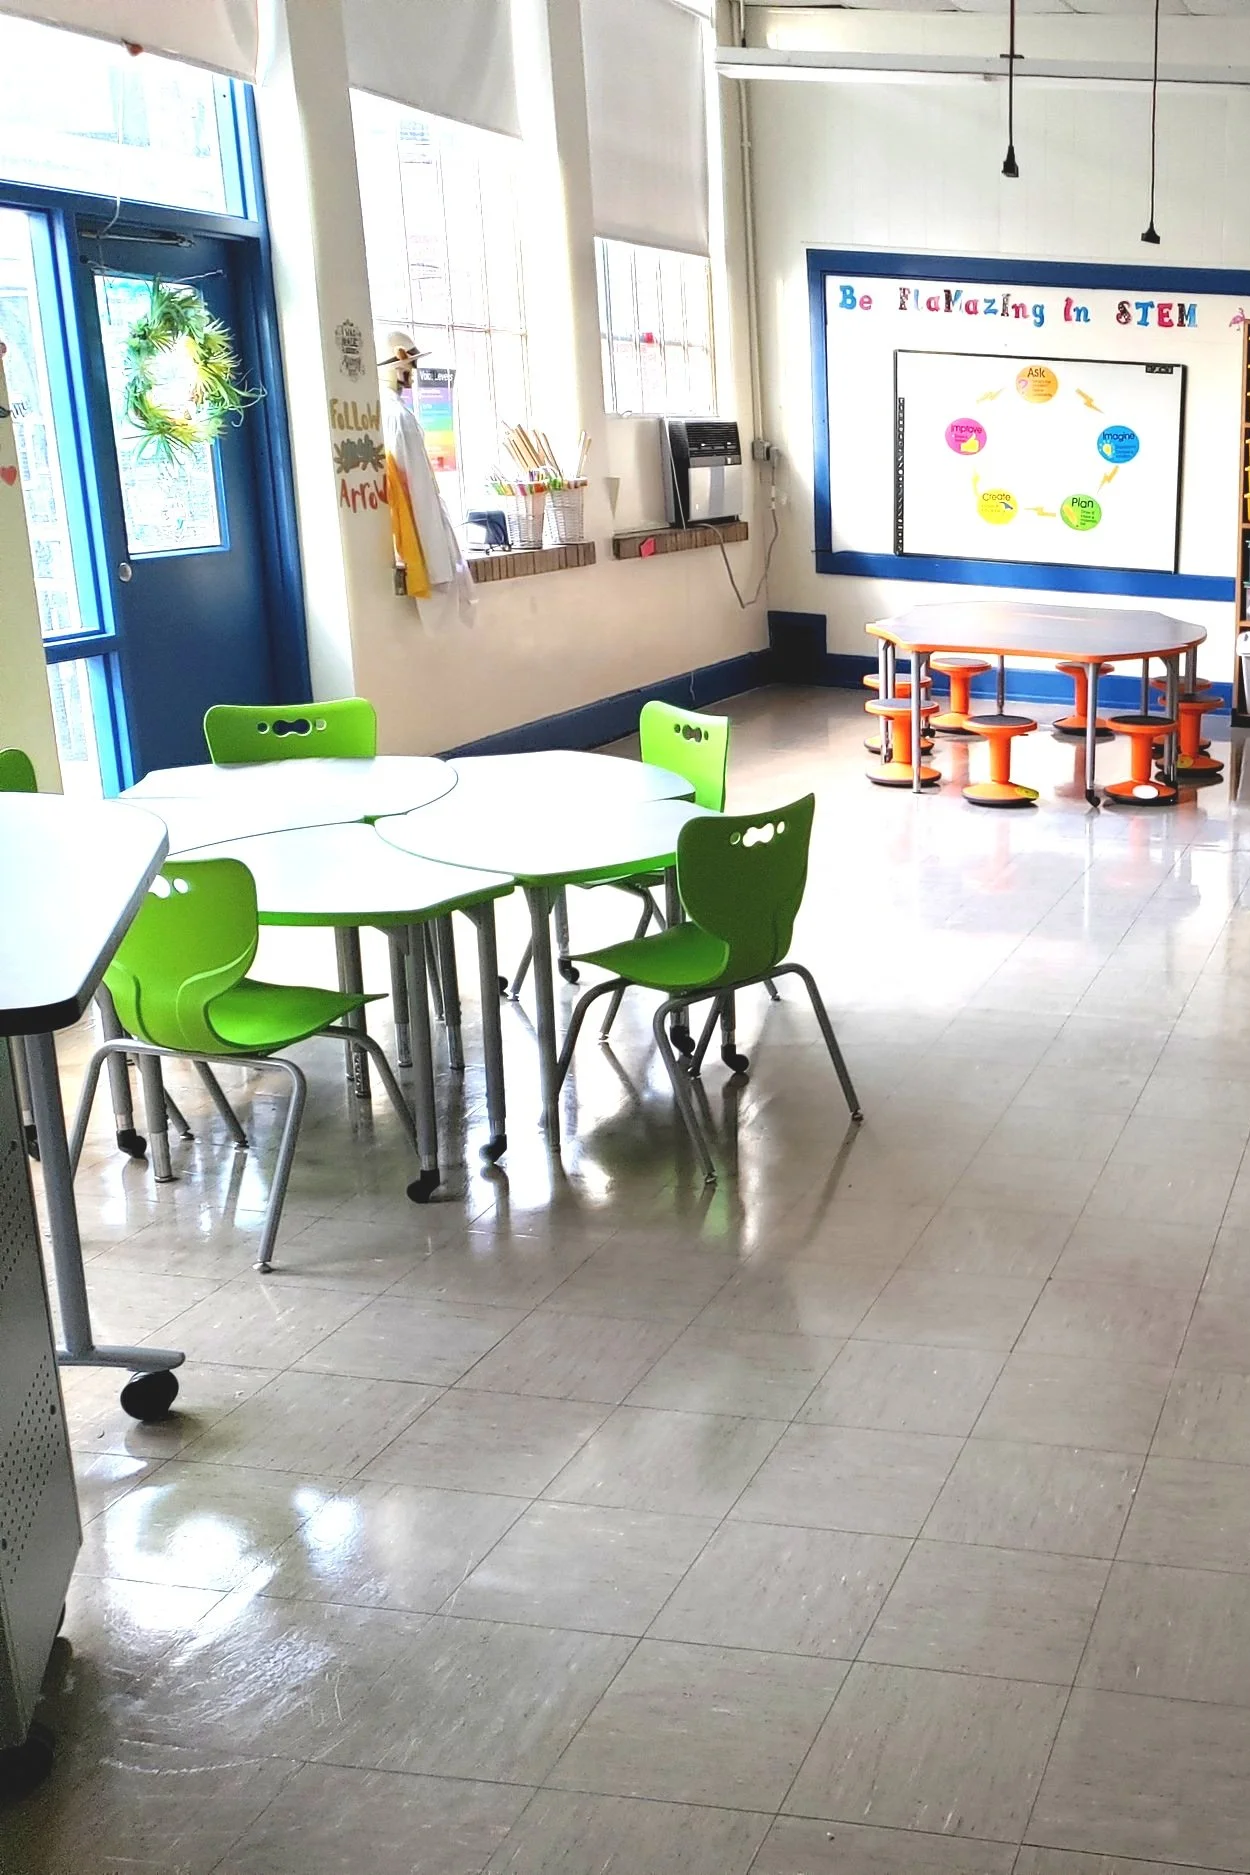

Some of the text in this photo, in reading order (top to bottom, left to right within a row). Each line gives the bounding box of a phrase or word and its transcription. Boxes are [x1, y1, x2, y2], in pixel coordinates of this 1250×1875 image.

[839, 285, 873, 311] Be
[1063, 297, 1091, 323] In
[1116, 301, 1198, 328] STEM
[1027, 367, 1046, 378] Ask
[951, 424, 983, 434] Improve
[1102, 431, 1136, 442] Imagine
[982, 493, 1012, 501] Create
[1071, 497, 1094, 508] Plan
